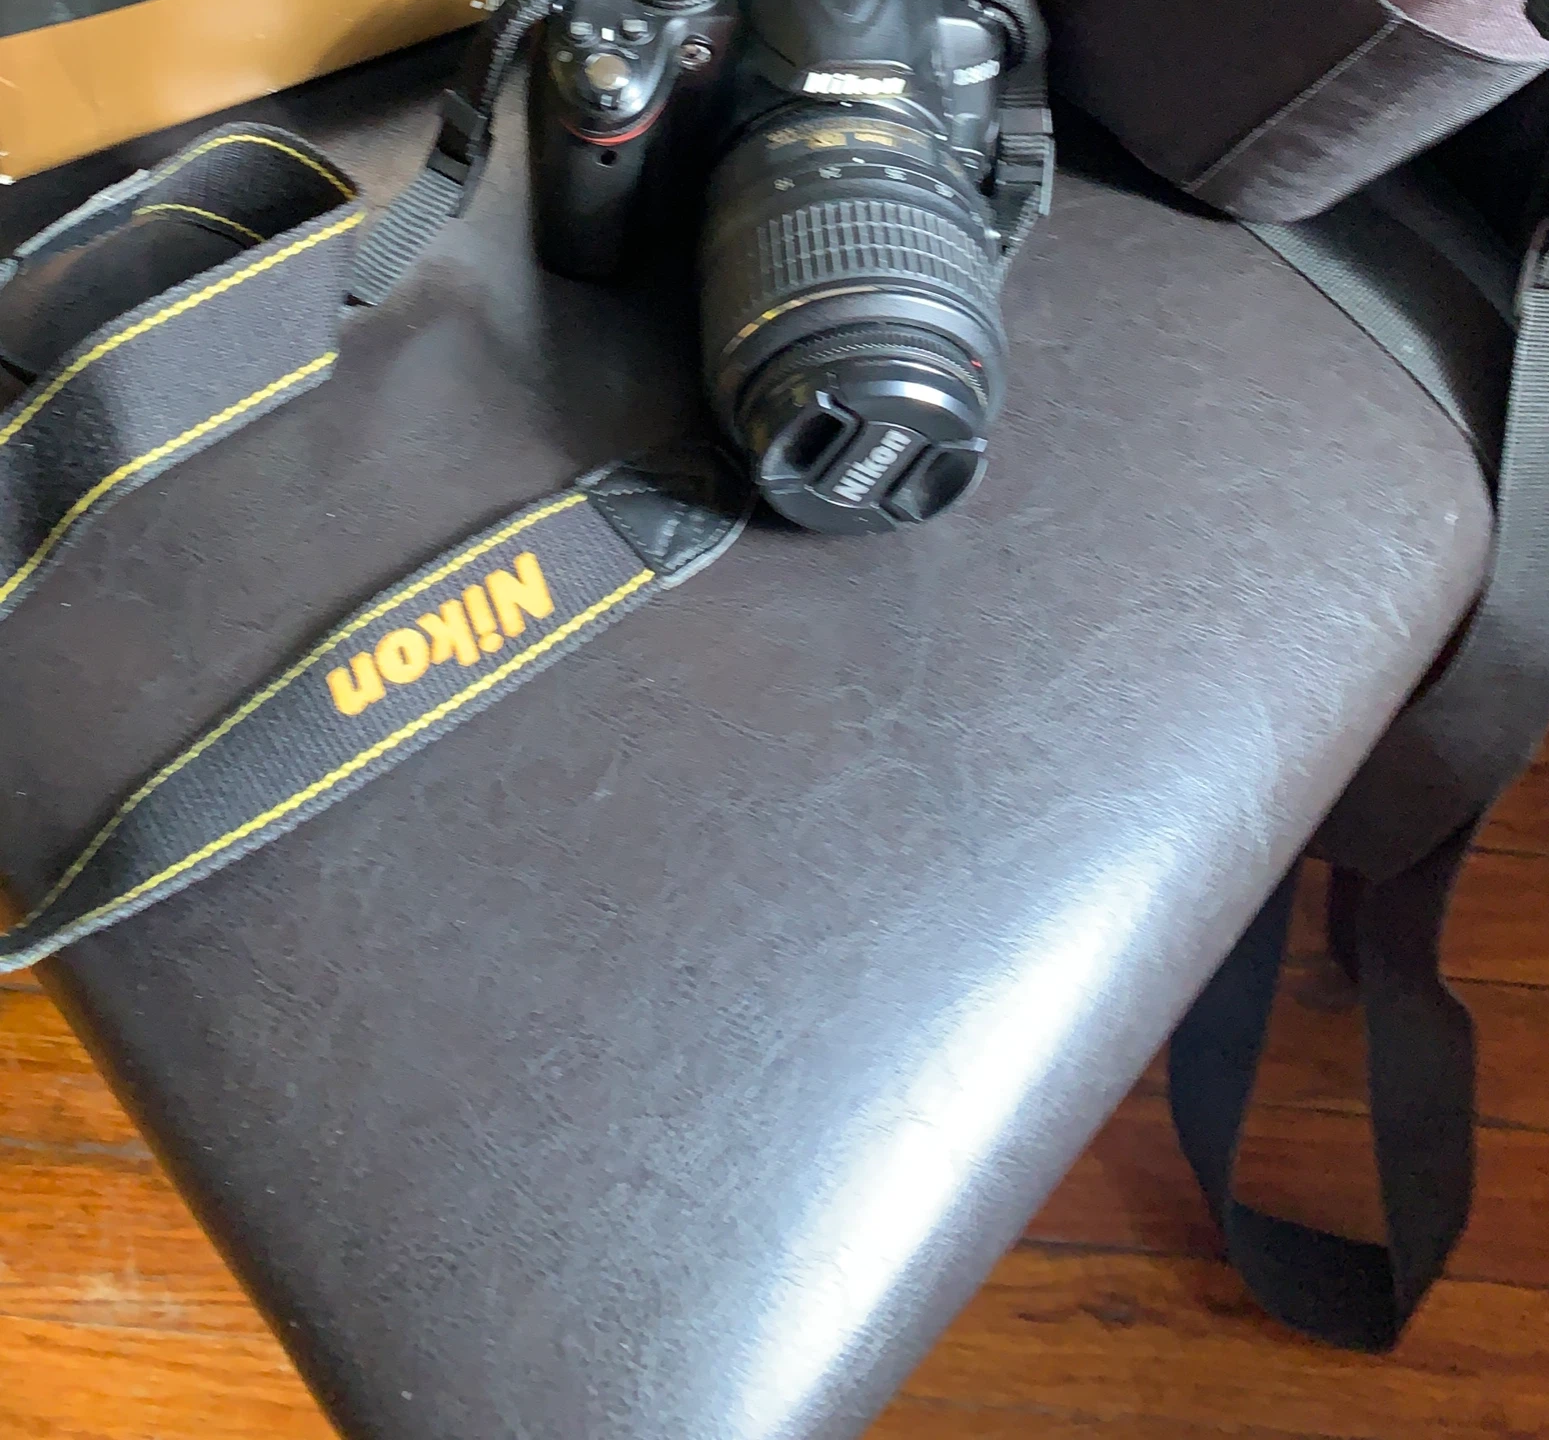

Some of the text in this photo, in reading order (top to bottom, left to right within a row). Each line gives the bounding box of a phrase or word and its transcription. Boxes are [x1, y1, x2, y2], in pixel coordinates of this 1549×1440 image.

[802, 71, 906, 95] Nikon
[832, 428, 912, 502] Nikon
[325, 551, 555, 717] Nikon
